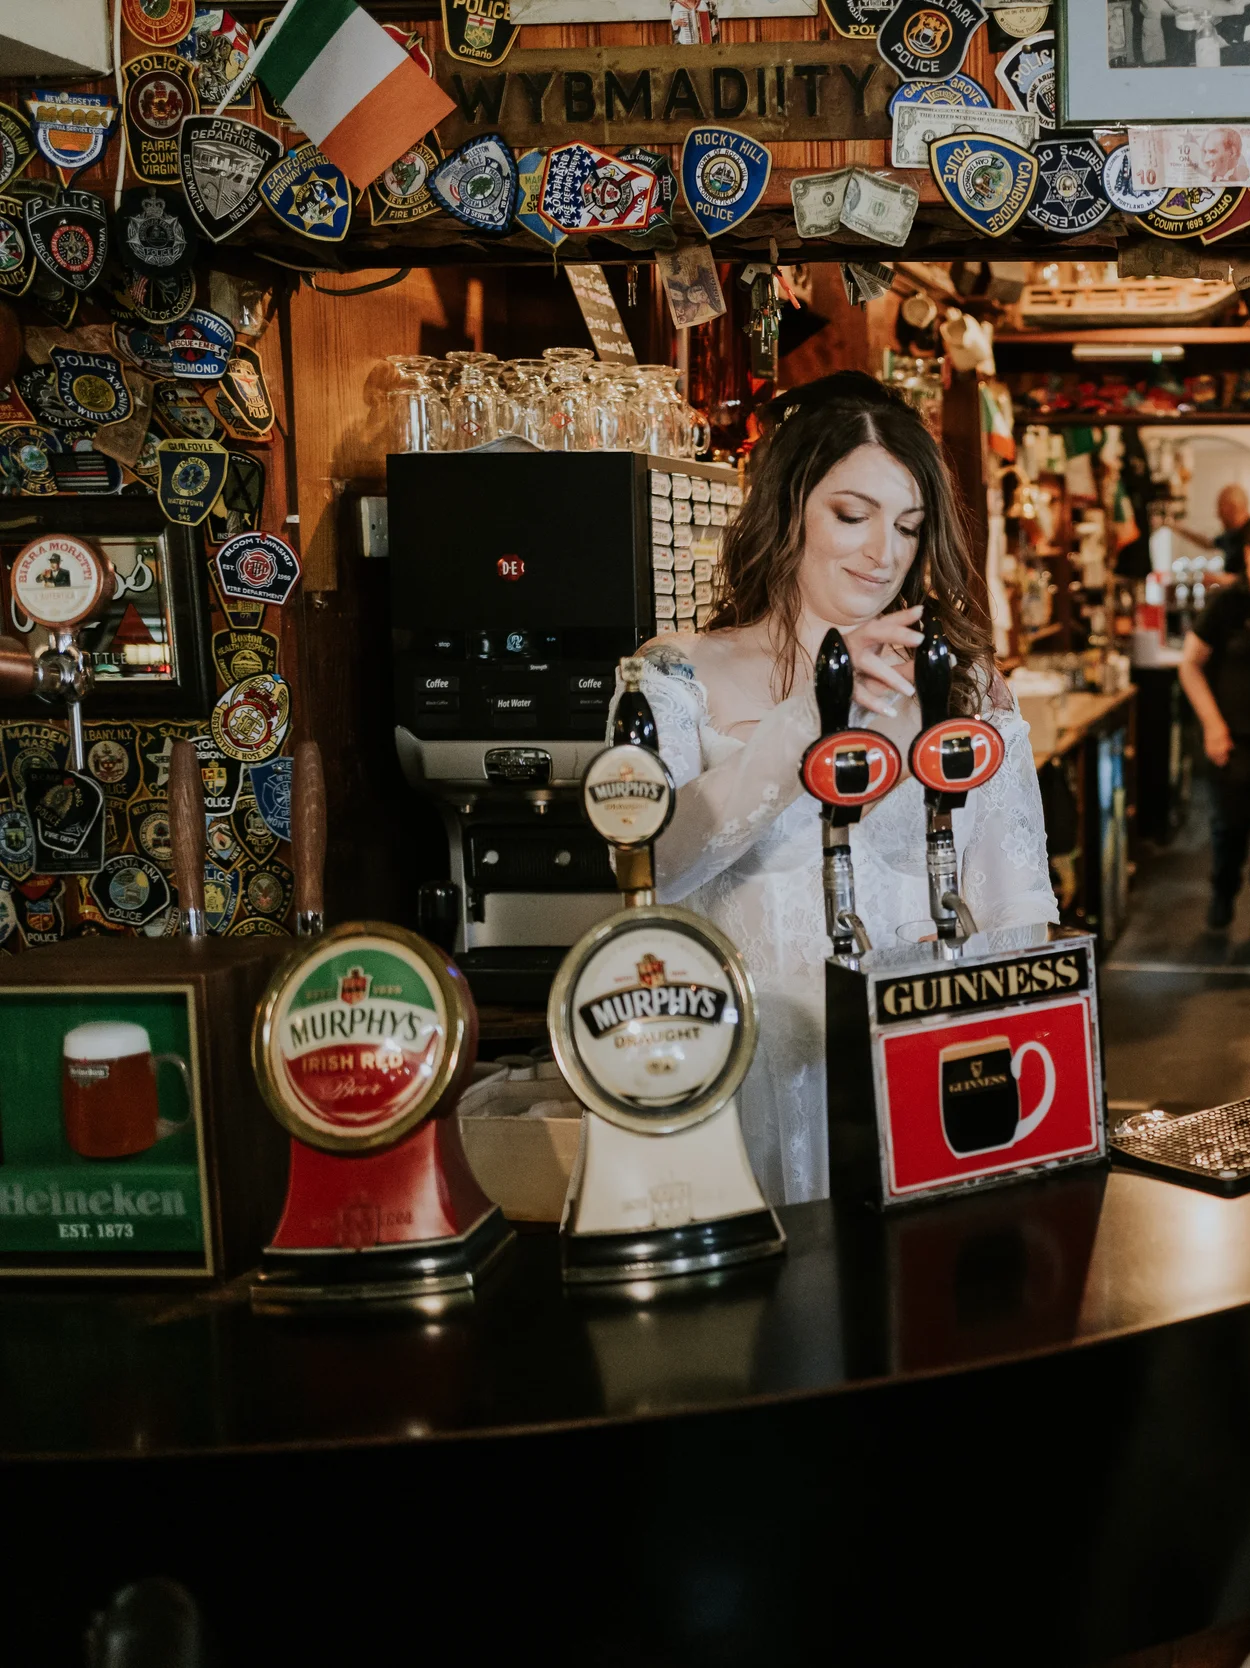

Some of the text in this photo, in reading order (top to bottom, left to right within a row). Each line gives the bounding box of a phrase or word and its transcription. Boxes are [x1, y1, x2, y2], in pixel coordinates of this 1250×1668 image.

[946, 0, 978, 28] PARK
[458, 44, 493, 60] Ontario
[890, 42, 941, 73] POLICE
[130, 57, 186, 77] POLICE
[45, 95, 62, 104] NEW
[950, 78, 983, 106] GROVE
[141, 140, 179, 152] FAIRFA
[190, 129, 272, 162] DEPARTMENT
[694, 133, 765, 165] ROCKY HILL
[1177, 145, 1191, 155] 10
[141, 164, 180, 175] VIRGIN
[635, 155, 656, 166] COUNTY
[943, 141, 973, 184] POLICE
[183, 154, 206, 214] EDGEWATER
[269, 165, 304, 206] HIGHWAY
[551, 152, 571, 215] SOUTHARD
[563, 150, 582, 207] DEPARTMENT
[1136, 169, 1157, 186] 10
[985, 161, 1032, 233] CAMBRIDGE
[229, 204, 248, 223] NEW
[388, 200, 438, 219] FIRE DEPT.
[470, 209, 490, 222] SERVE
[695, 201, 735, 223] POLICE
[1030, 197, 1110, 234] MIDDLESEX
[1154, 217, 1184, 232] COUNTY
[1204, 194, 1233, 223] OFFICE
[32, 232, 61, 272] PURCELL
[88, 227, 107, 278] OKLAHOMA
[198, 341, 217, 351] EMS
[55, 354, 118, 373] POLICE
[60, 371, 112, 421] CITY OF WHITE
[39, 410, 86, 428] POLICE
[167, 442, 214, 452] GUILFOYLE
[167, 497, 205, 508] WATERTOWN
[224, 537, 294, 569] BLOOM TOWNSHIP
[18, 541, 94, 585] BIRRA MORETTI
[221, 563, 236, 572] EST.
[226, 584, 285, 601] FIRE DEPARTMENT
[229, 632, 264, 644] Boston
[438, 641, 451, 649] stop
[425, 678, 449, 689] Coffee
[578, 678, 602, 689] Coffee
[497, 698, 532, 708] Hot Water
[6, 728, 70, 748] MALDEN
[241, 749, 263, 760] HOSE
[132, 803, 149, 816] WEST
[44, 829, 60, 841] FIRE
[51, 848, 90, 860] Canada
[105, 858, 161, 884] SANTA ANA
[108, 906, 145, 922] POLICE
[27, 932, 59, 943] POLICE
[882, 955, 1081, 1017] GUINNESS
[613, 1026, 701, 1050] DRAUGHT
[302, 1051, 405, 1073] IRISH RED
[948, 1073, 1008, 1093] GUINNESS
[0, 1182, 187, 1218] Heineken
[58, 1223, 134, 1238] EST. 1873
